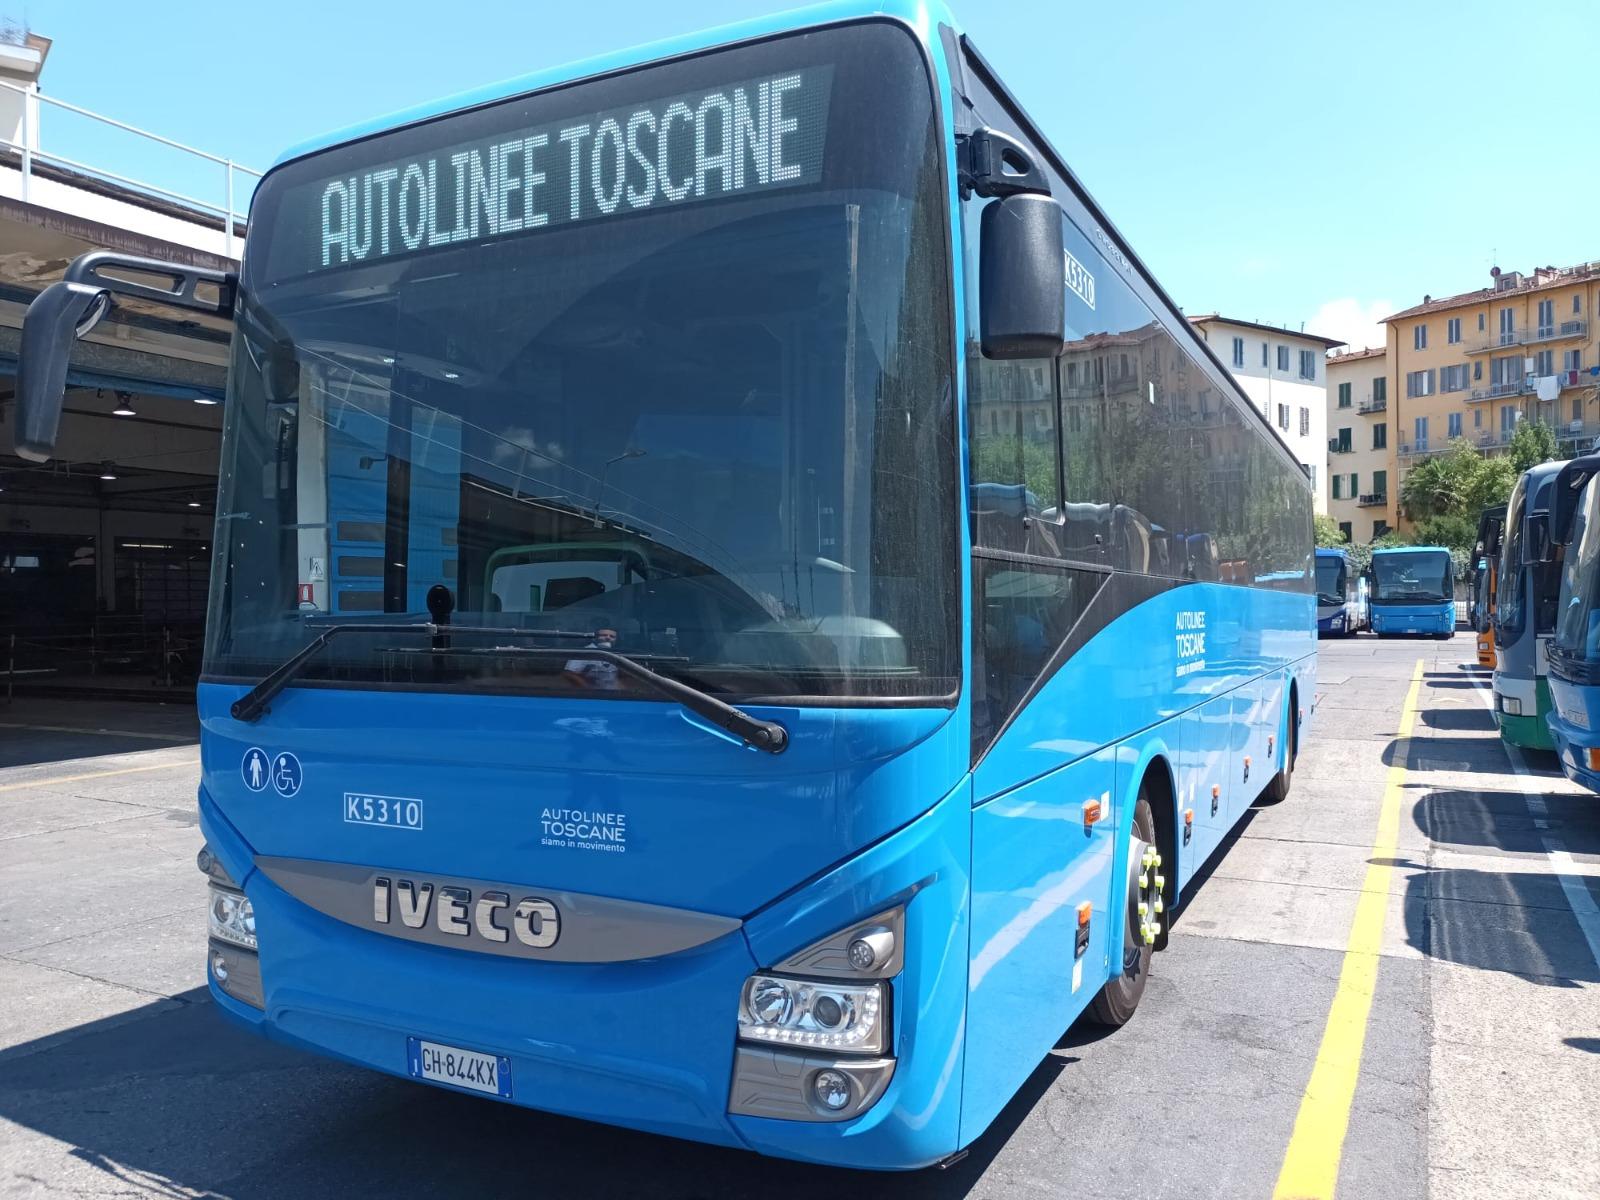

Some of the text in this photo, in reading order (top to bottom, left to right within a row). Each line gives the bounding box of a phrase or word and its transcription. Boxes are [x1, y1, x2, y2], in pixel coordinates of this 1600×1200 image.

[322, 75, 801, 266] AUTOLINEE TOSCANE
[1064, 252, 1094, 305] K5310
[1176, 611, 1205, 630] AUTOLINEE
[1176, 632, 1205, 658] TOSCANE
[348, 796, 419, 826] K5310
[541, 808, 625, 826] AUTOLINEE
[541, 820, 625, 842] TOSCANE
[541, 837, 625, 852] siamo in movimento
[374, 876, 561, 949] IVECO
